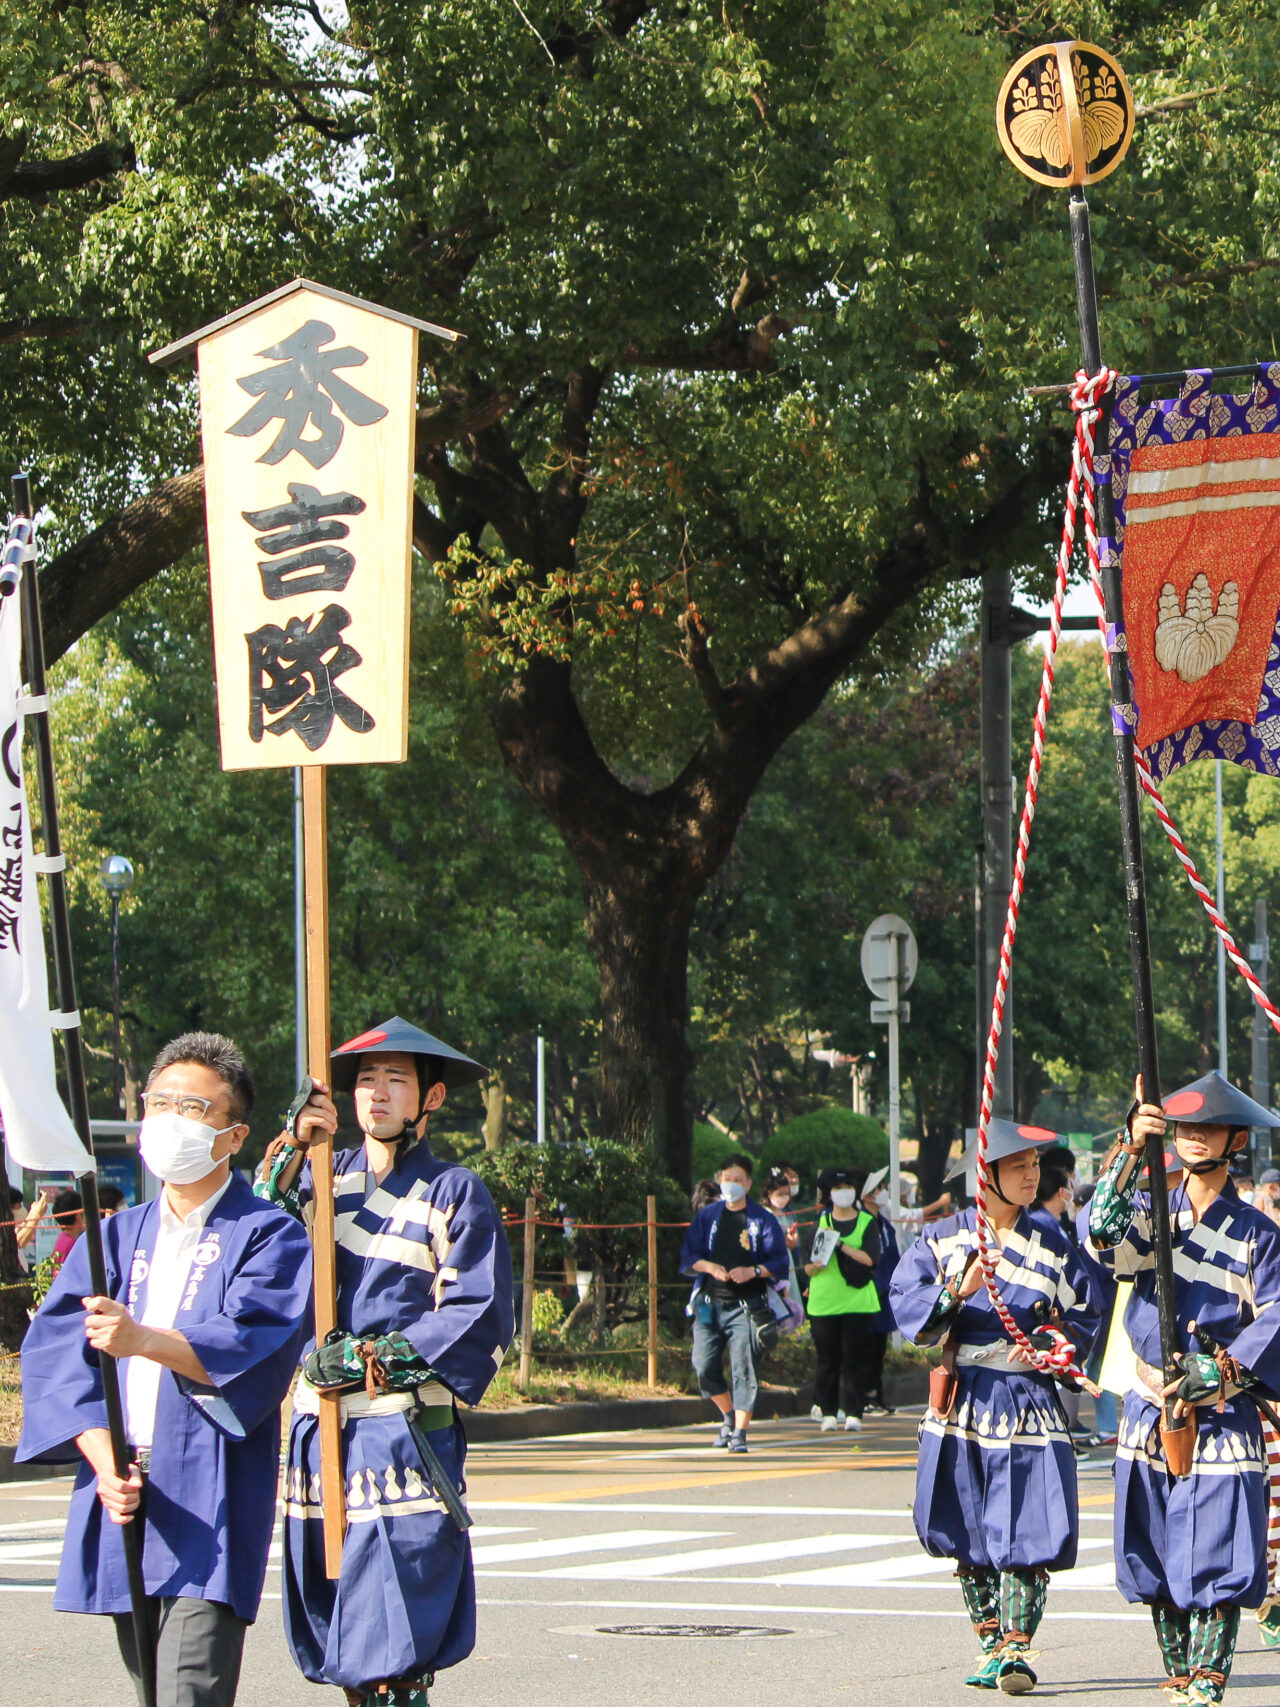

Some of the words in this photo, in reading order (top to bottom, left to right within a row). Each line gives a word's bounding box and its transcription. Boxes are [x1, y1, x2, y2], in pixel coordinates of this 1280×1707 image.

[226, 319, 389, 752] 秀吉隊
[204, 1232, 220, 1243] JR
